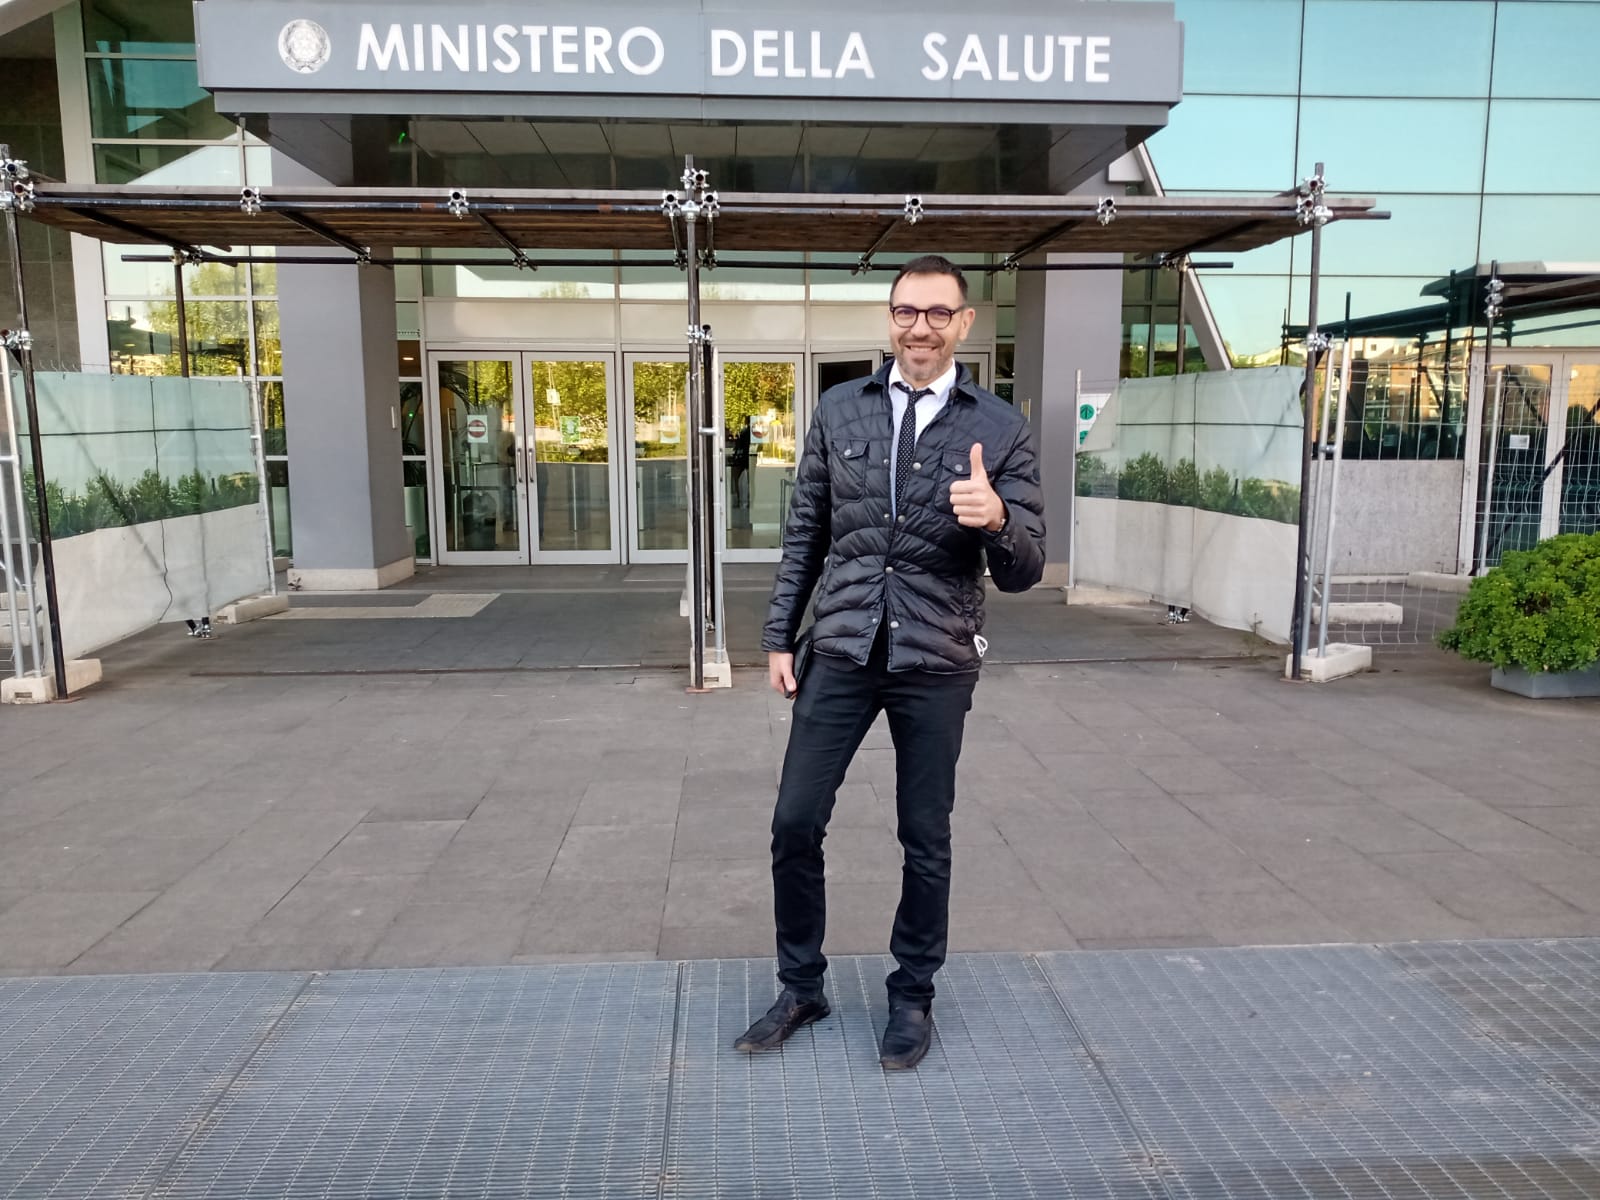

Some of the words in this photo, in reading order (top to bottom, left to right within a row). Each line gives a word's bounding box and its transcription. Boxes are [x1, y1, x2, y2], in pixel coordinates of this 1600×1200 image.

[356, 23, 664, 76] MINISTERO
[710, 29, 875, 79] DELLA
[921, 31, 1110, 82] SALUTE
